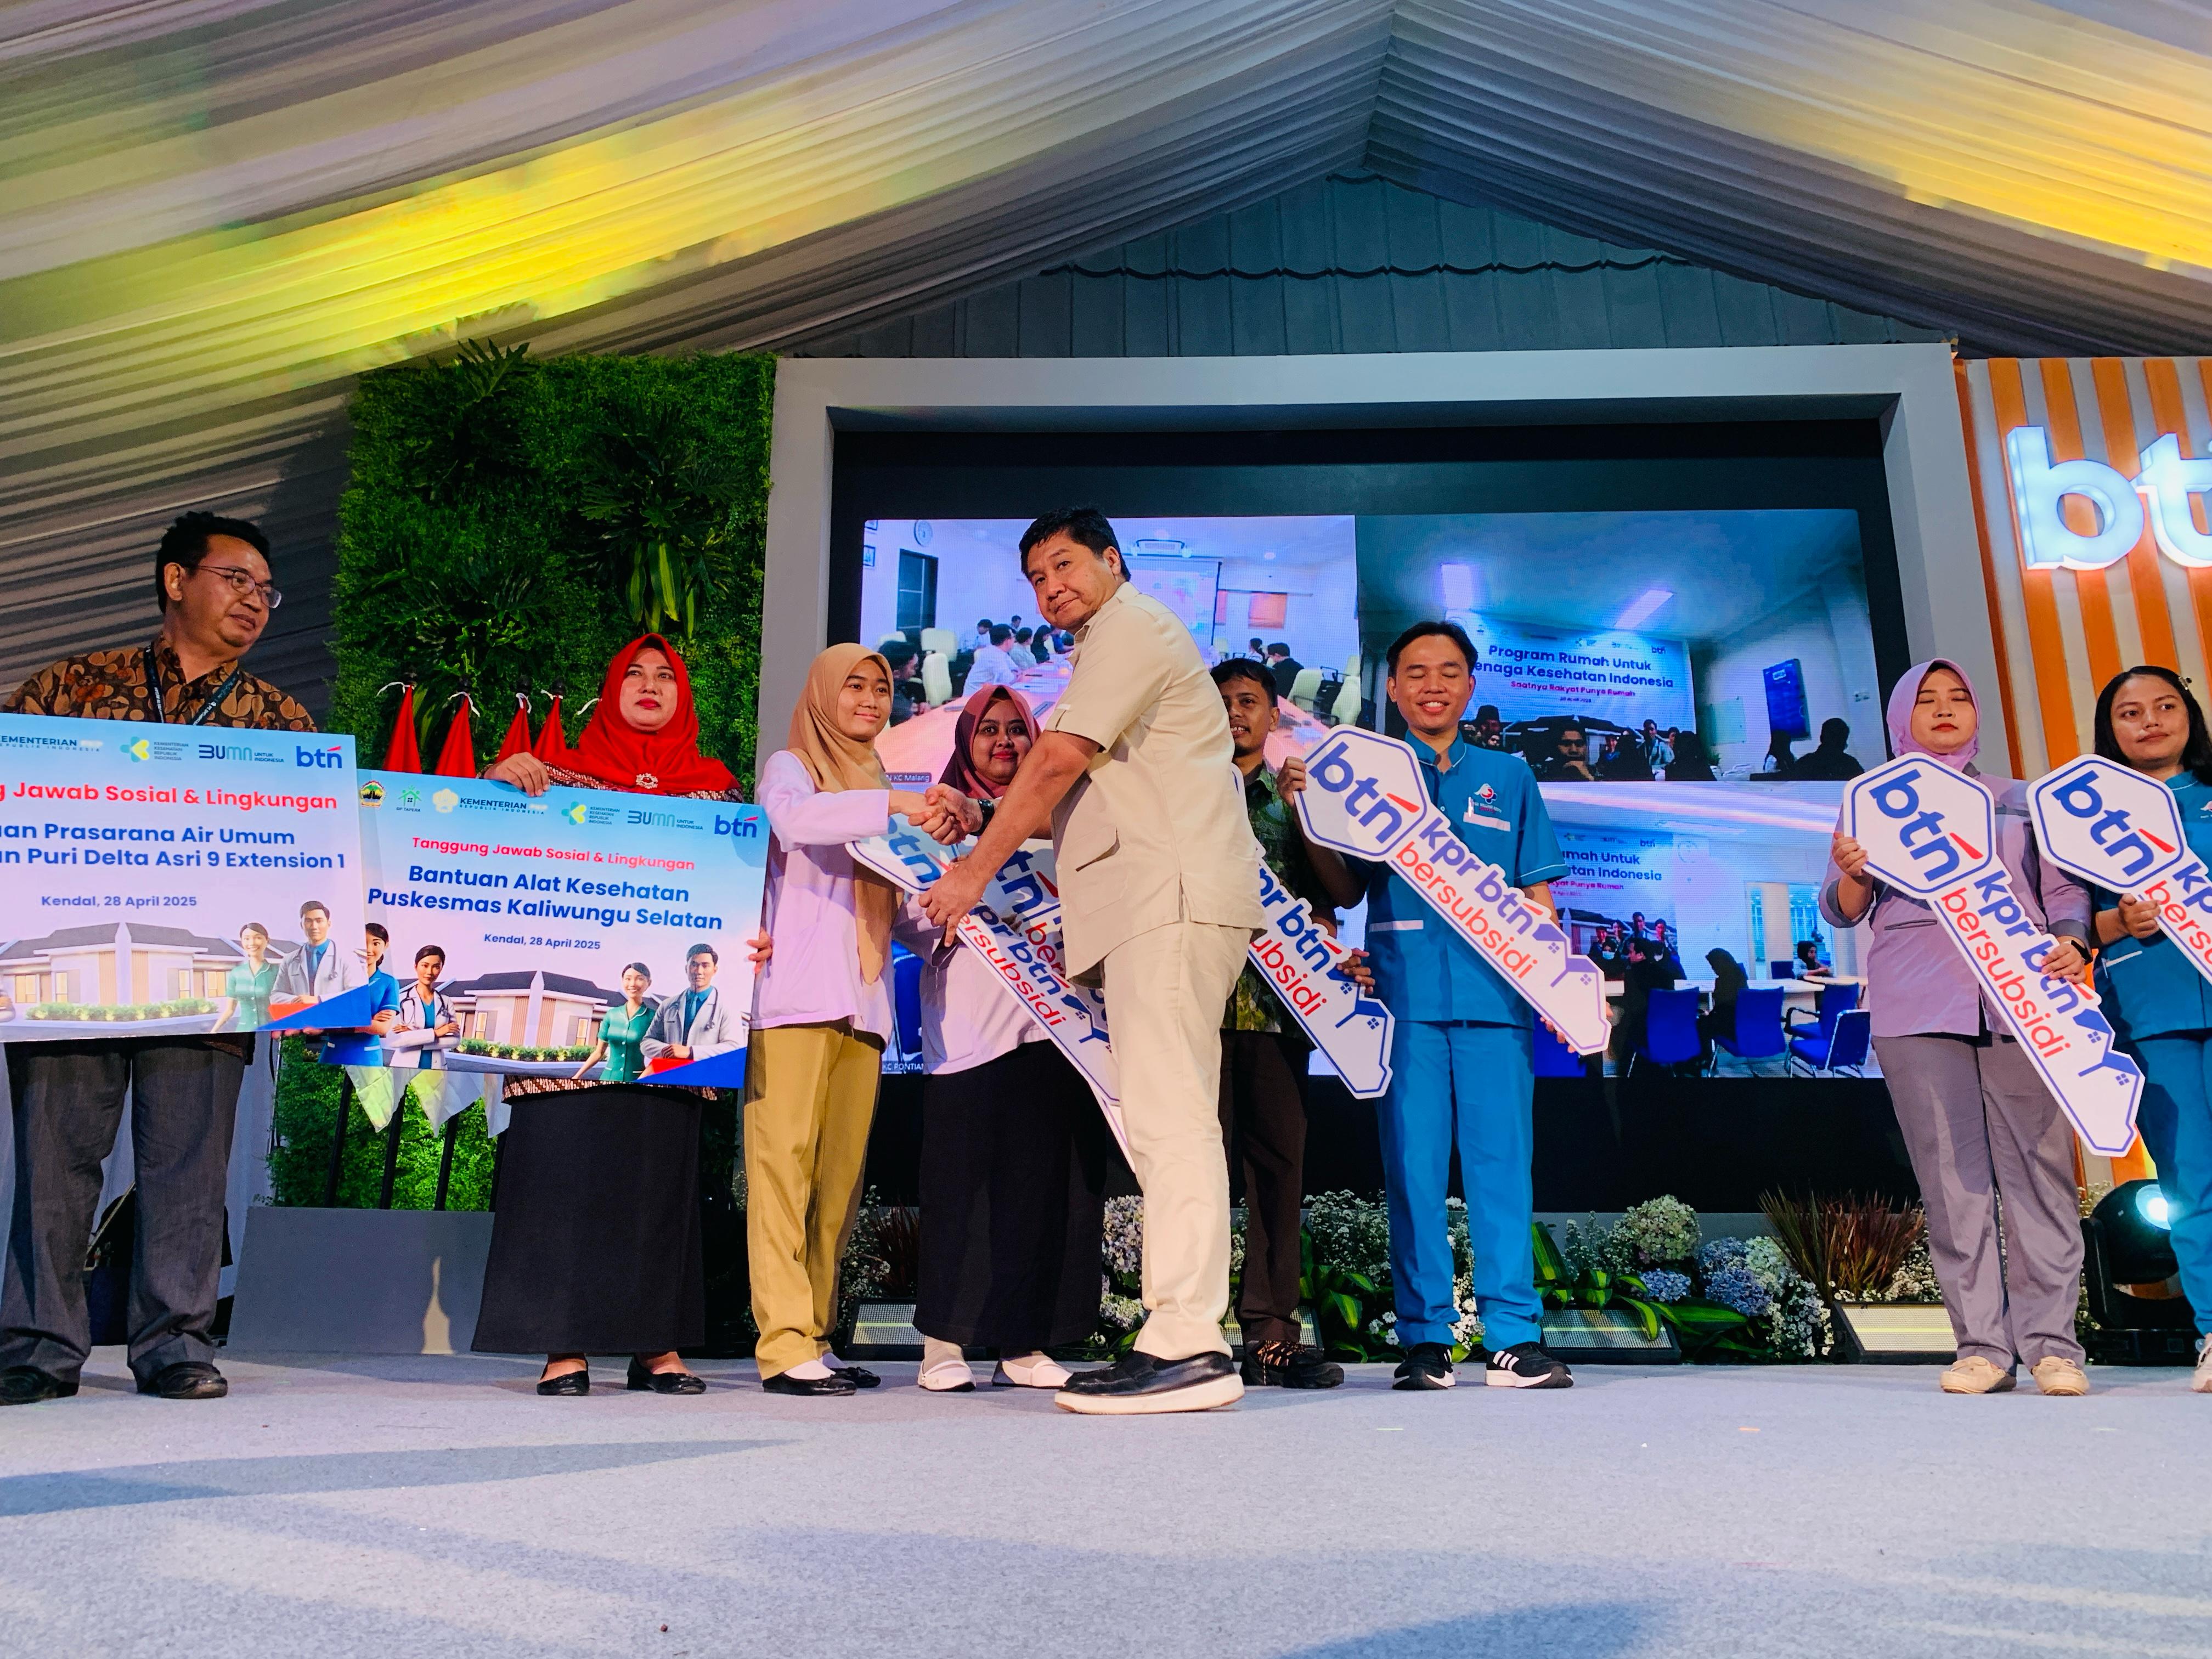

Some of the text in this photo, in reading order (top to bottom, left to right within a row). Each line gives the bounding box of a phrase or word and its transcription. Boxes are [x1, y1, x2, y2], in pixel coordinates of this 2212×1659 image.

[2006, 426, 2212, 571] bt
[1489, 645, 1651, 670] Program Rumah Untuk
[1475, 662, 1674, 688] enaga Kesehatan Indonesia
[1549, 684, 1579, 693] Rakyat
[1581, 687, 1606, 696] Punya
[0, 736, 77, 746] EMENTERIAN
[13, 782, 99, 800] Jawab
[105, 786, 177, 803] Sosial
[184, 789, 200, 804] &
[206, 789, 337, 812] Lingkungan
[460, 798, 527, 809] KEMENTERIAN
[44, 823, 174, 842] Prasarana
[181, 826, 213, 842] Air
[219, 828, 295, 844] Umum
[1419, 816, 1482, 876] kpr
[28, 848, 77, 864] Puri
[84, 849, 149, 866] Delta
[155, 850, 201, 866] Asri
[207, 851, 220, 866] 9
[226, 852, 332, 868] Extension
[337, 854, 345, 868] 1
[413, 837, 695, 872] Tanggung Jawab Sosial & Lingkungan
[1601, 853, 1640, 865] Untuk
[409, 865, 689, 902] Bantuan Alat Kesehatan
[996, 850, 1059, 915] tn
[1598, 867, 1662, 881] Indonesia
[2172, 862, 2212, 913] kp
[41, 896, 197, 909] Kendal, 28 April 2025
[368, 888, 722, 929] Puskesmas Kaliwungu Selatan
[1395, 841, 1538, 980] bersubsidi
[1973, 870, 2036, 936] kpr
[484, 934, 600, 950] Kendal, 28 April 2025
[960, 913, 1066, 1026] ersubsidi
[1941, 887, 2071, 1058] bersubsidi
